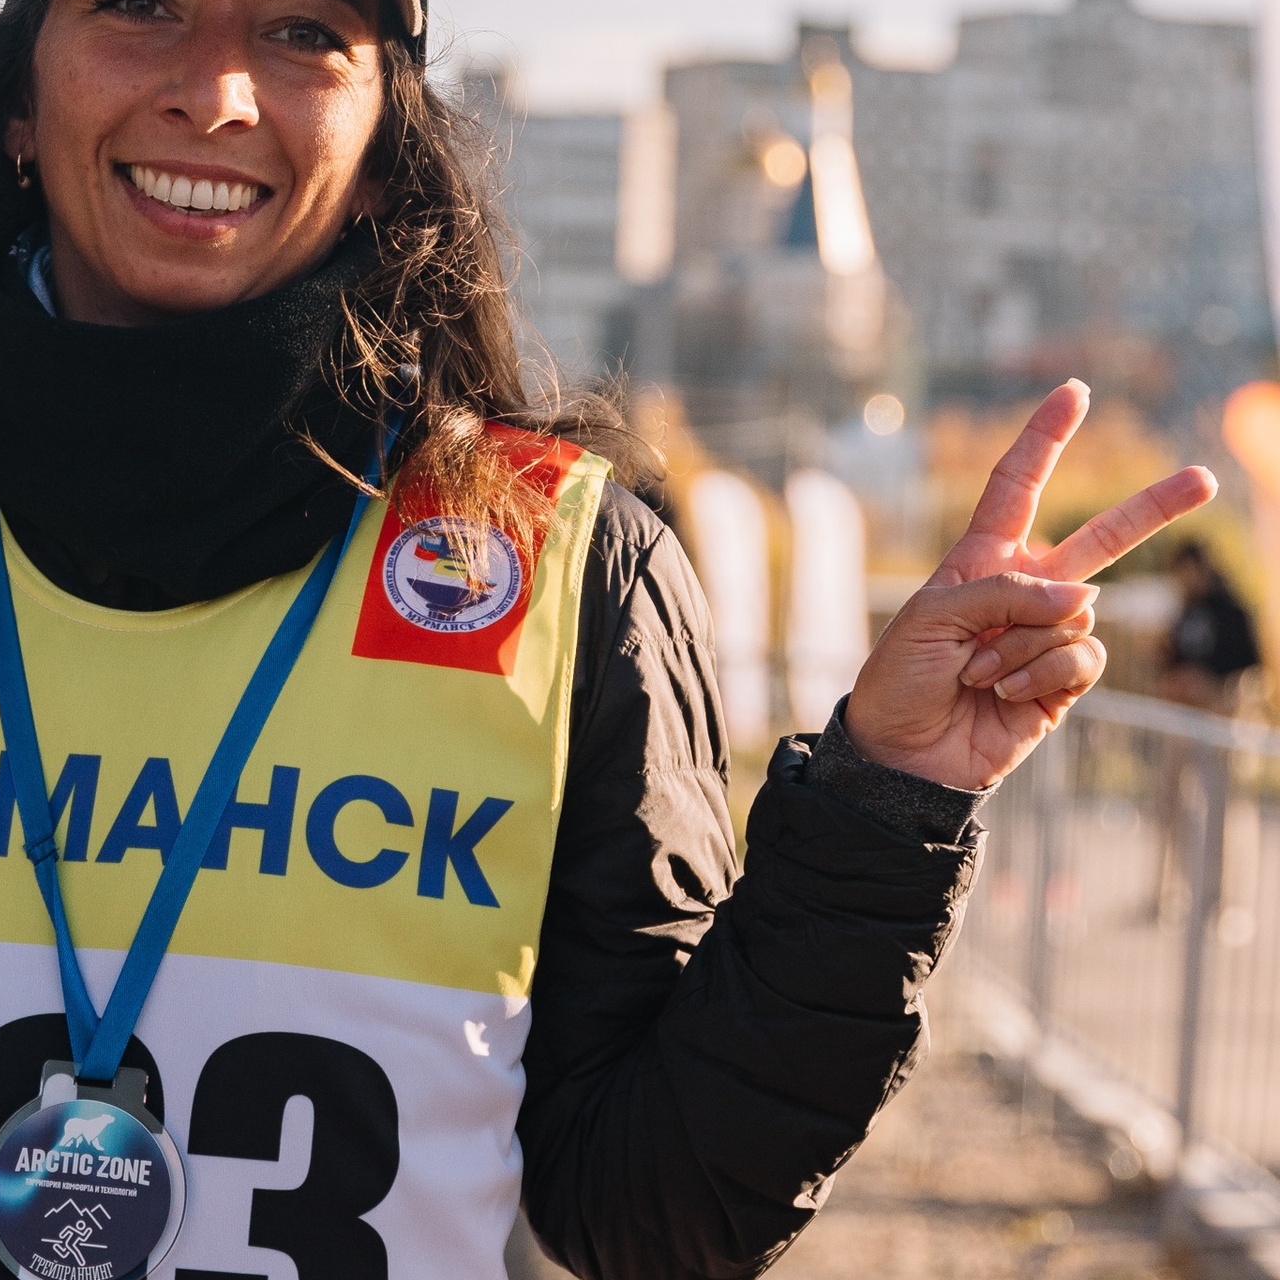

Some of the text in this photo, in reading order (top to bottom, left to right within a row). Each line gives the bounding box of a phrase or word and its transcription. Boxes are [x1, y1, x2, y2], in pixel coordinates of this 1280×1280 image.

[405, 610, 478, 631] МУРМАНСК
[15, 1147, 152, 1186] ARCTIC ZONE
[62, 1182, 94, 1193] КОМФОРТА
[95, 1185, 100, 1193] И
[100, 1186, 138, 1197] ТЕХНОЛОГИЙ
